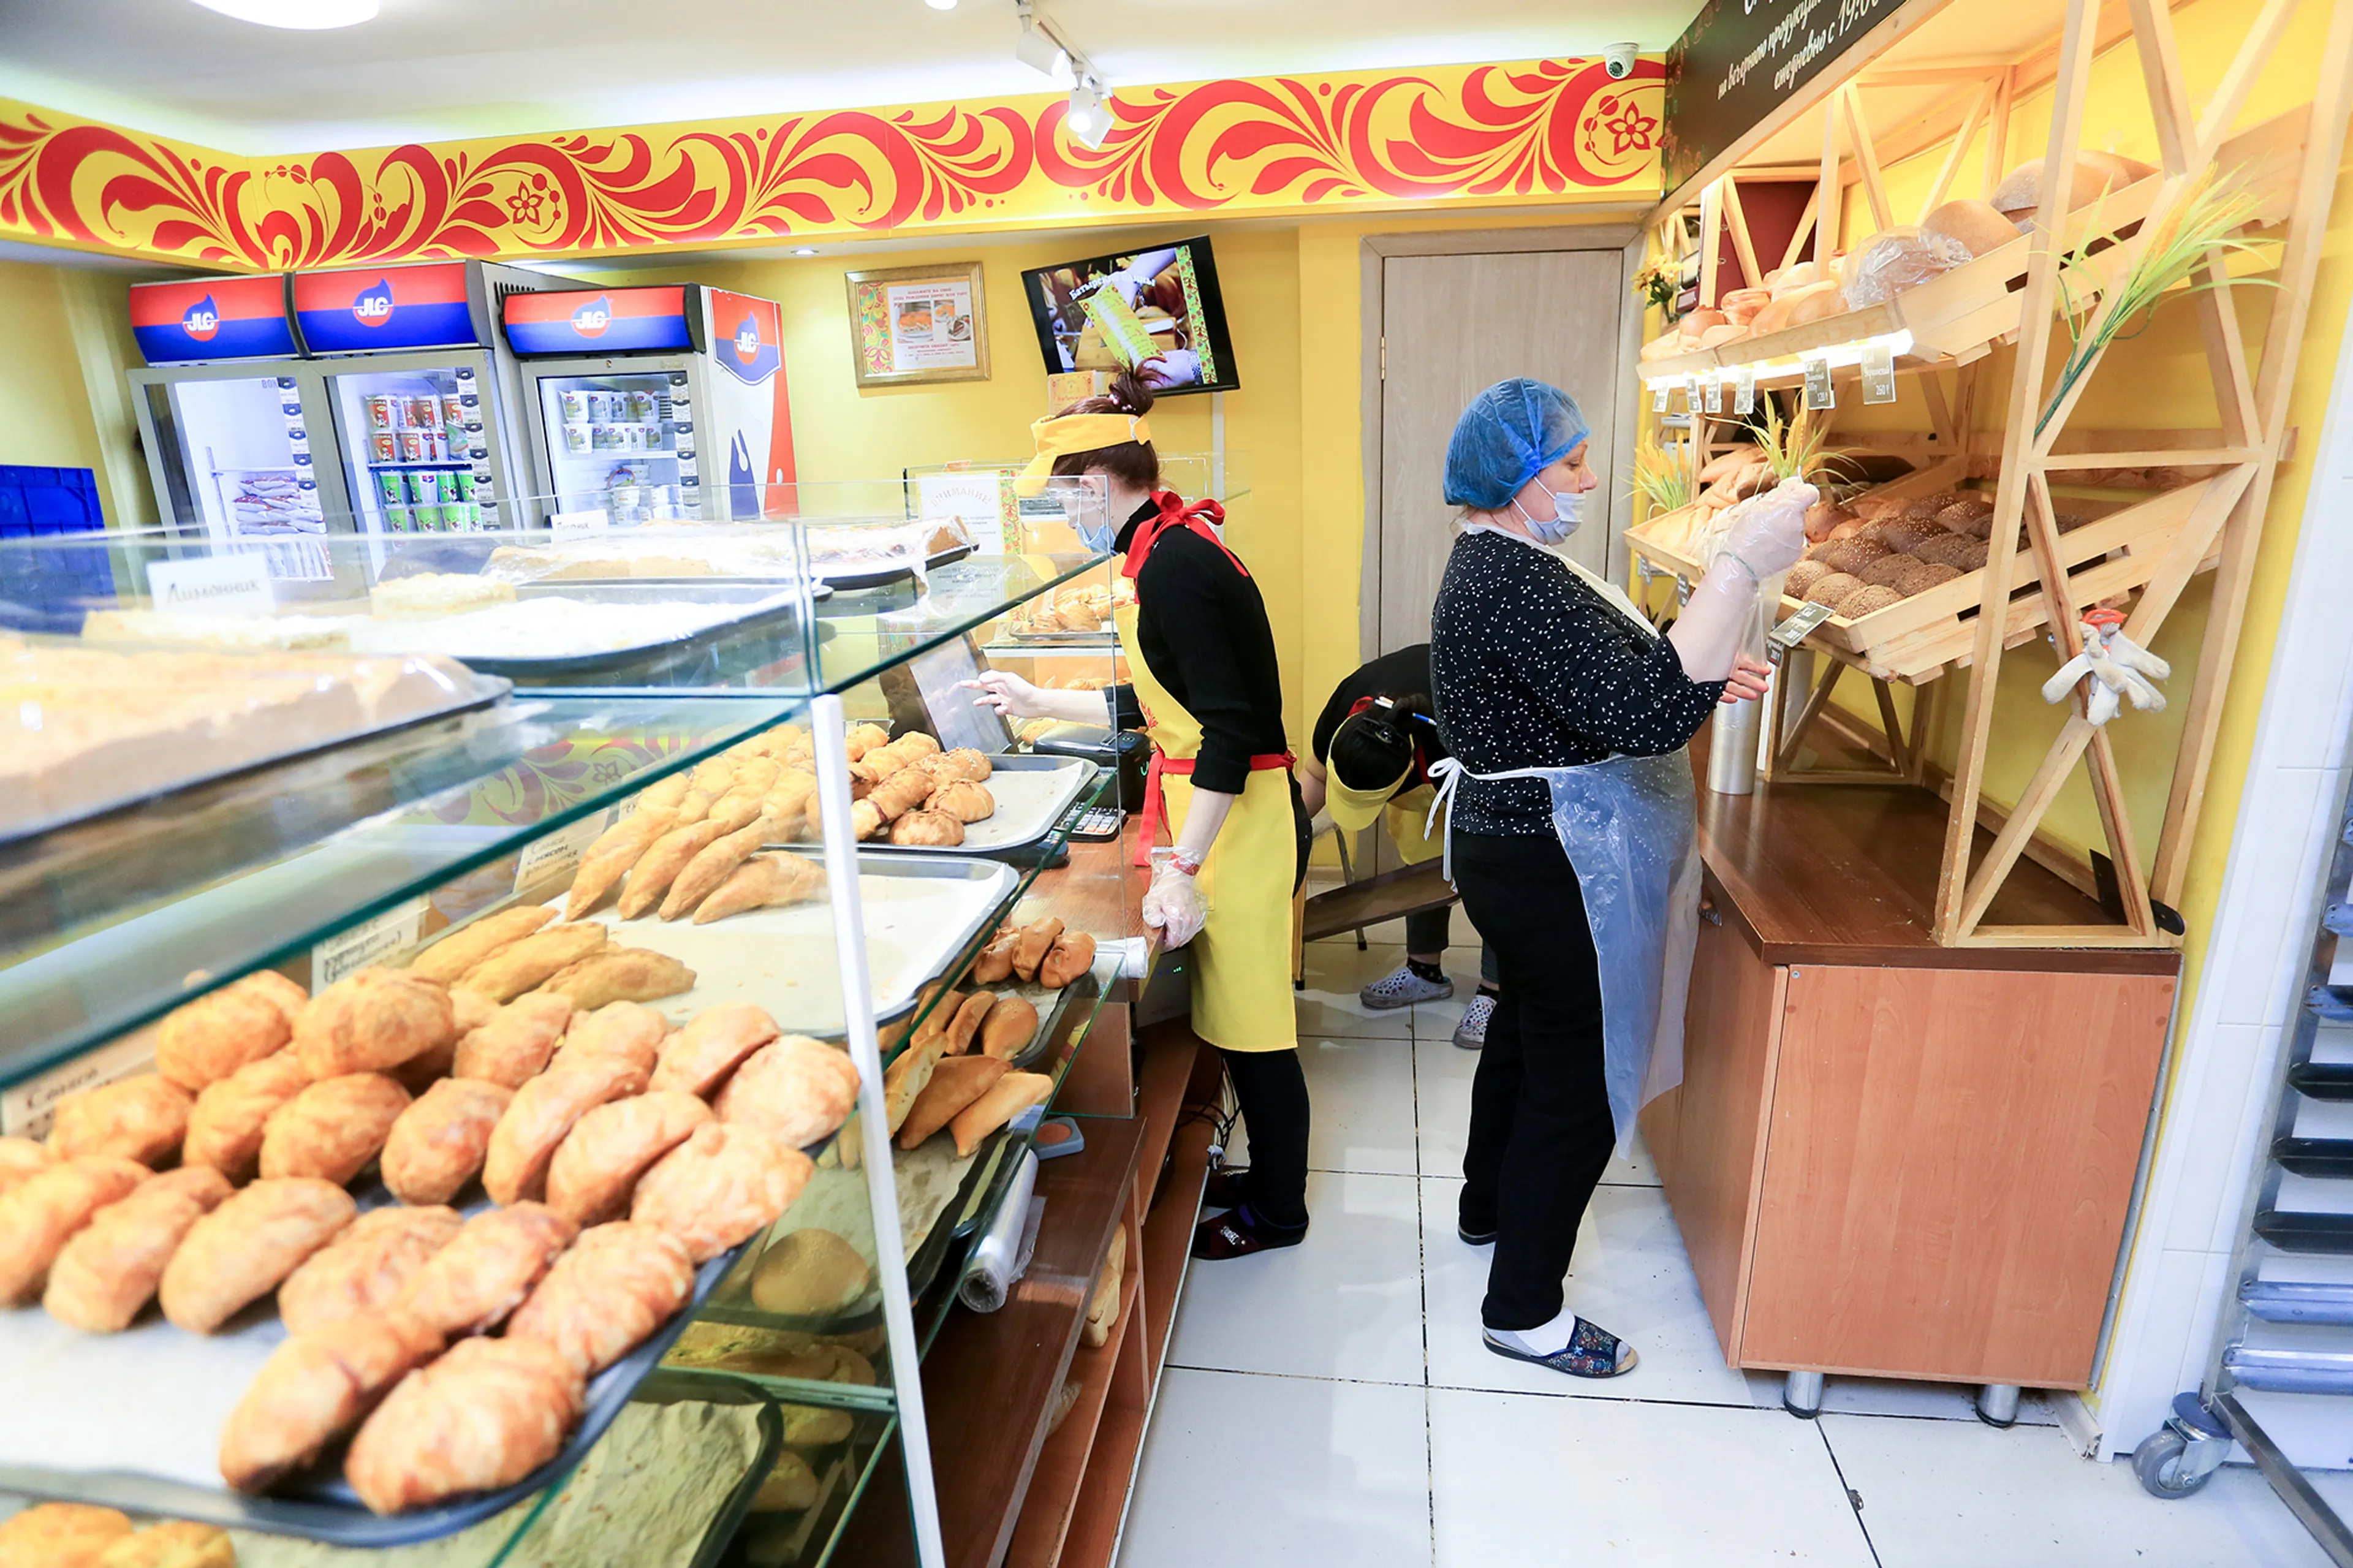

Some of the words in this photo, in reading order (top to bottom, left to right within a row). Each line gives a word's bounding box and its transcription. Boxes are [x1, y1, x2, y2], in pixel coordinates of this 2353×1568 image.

[1774, 29, 1827, 90] ежедневно
[1827, 21, 1836, 44] с
[357, 297, 388, 317] JLC
[187, 312, 215, 331] JLC
[575, 311, 606, 329] JLC
[737, 331, 757, 353] JLC
